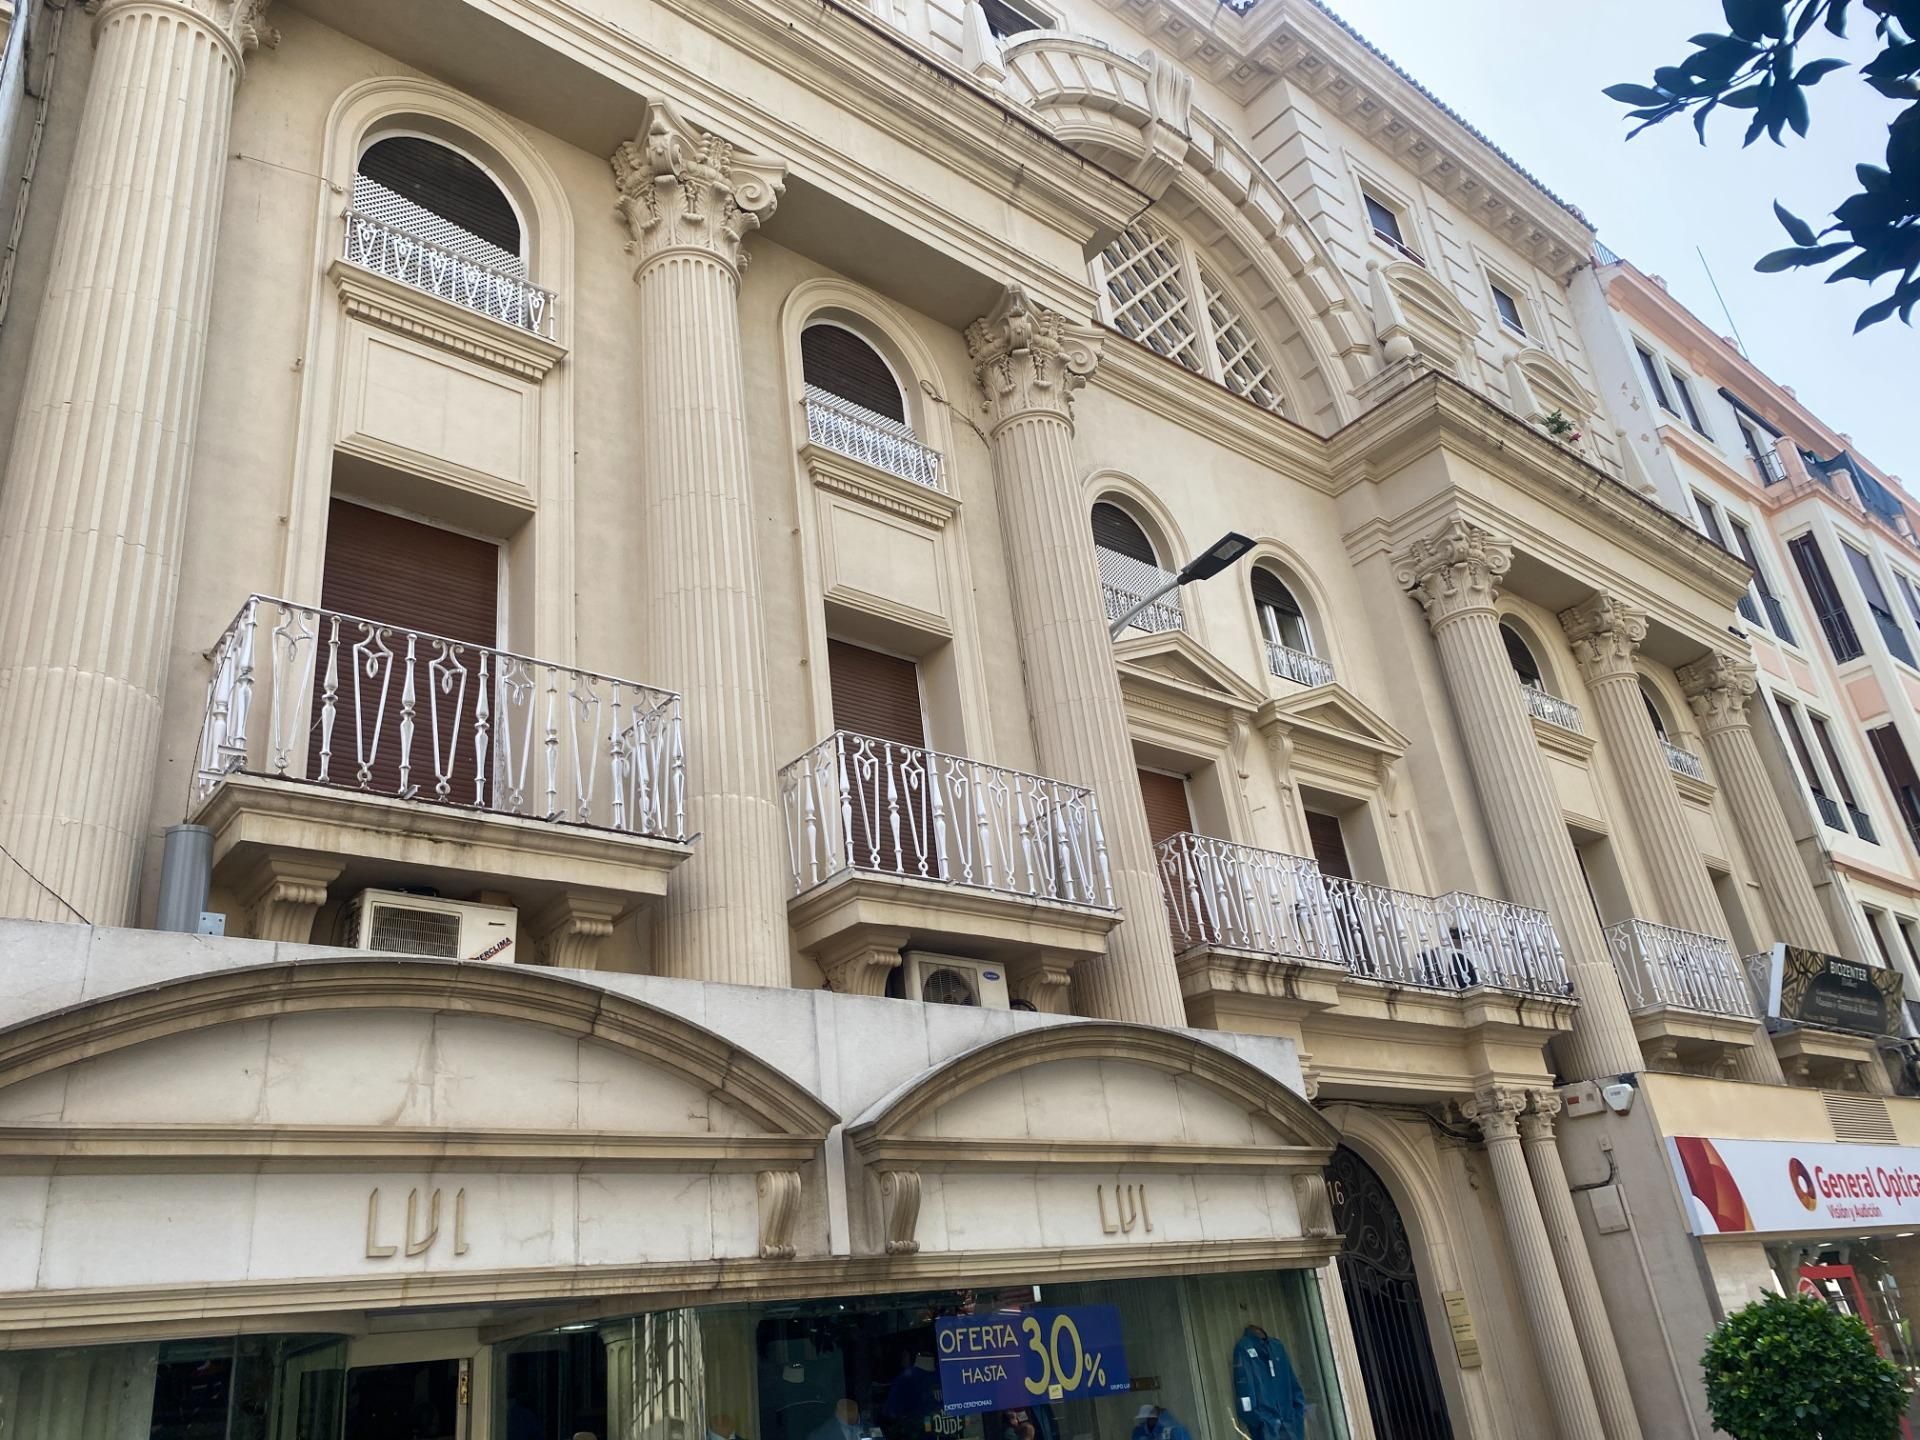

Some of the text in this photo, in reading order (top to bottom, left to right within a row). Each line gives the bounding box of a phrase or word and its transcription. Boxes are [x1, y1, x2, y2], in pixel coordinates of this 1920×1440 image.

[475, 937, 513, 961] ERCLIMA
[1327, 1180, 1345, 1205] 16
[1814, 1166, 1920, 1206] General Optica
[939, 1324, 1019, 1353] OFERTA
[1022, 1314, 1106, 1395] 30%
[961, 1365, 1008, 1385] HASTA
[963, 1399, 993, 1409] CEREMONIAS
